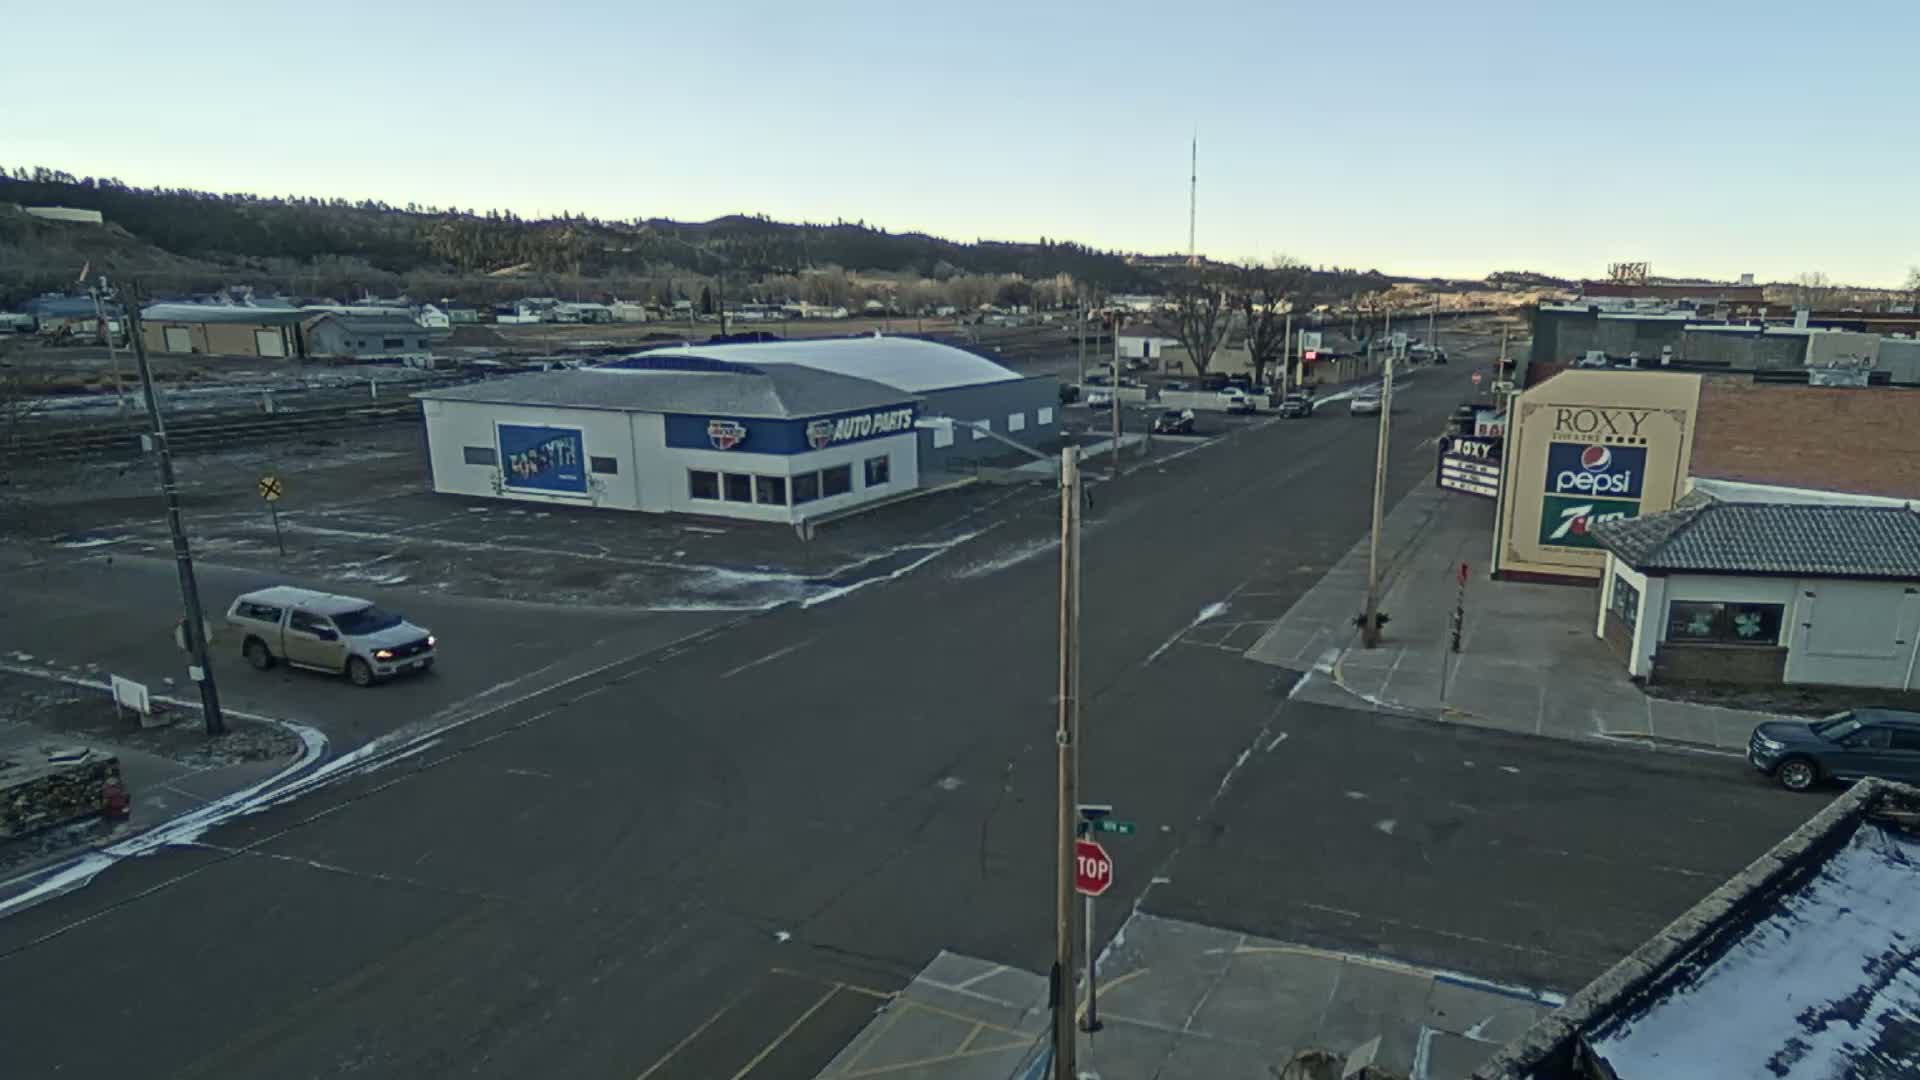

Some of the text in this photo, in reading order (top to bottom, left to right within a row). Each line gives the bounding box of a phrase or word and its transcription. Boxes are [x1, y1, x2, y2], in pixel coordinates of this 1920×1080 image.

[832, 414, 872, 442] AUTO
[872, 408, 913, 434] PARTS
[1556, 408, 1649, 436] ROXY
[1556, 470, 1631, 495] pepsi
[1077, 856, 1109, 881] TOP
